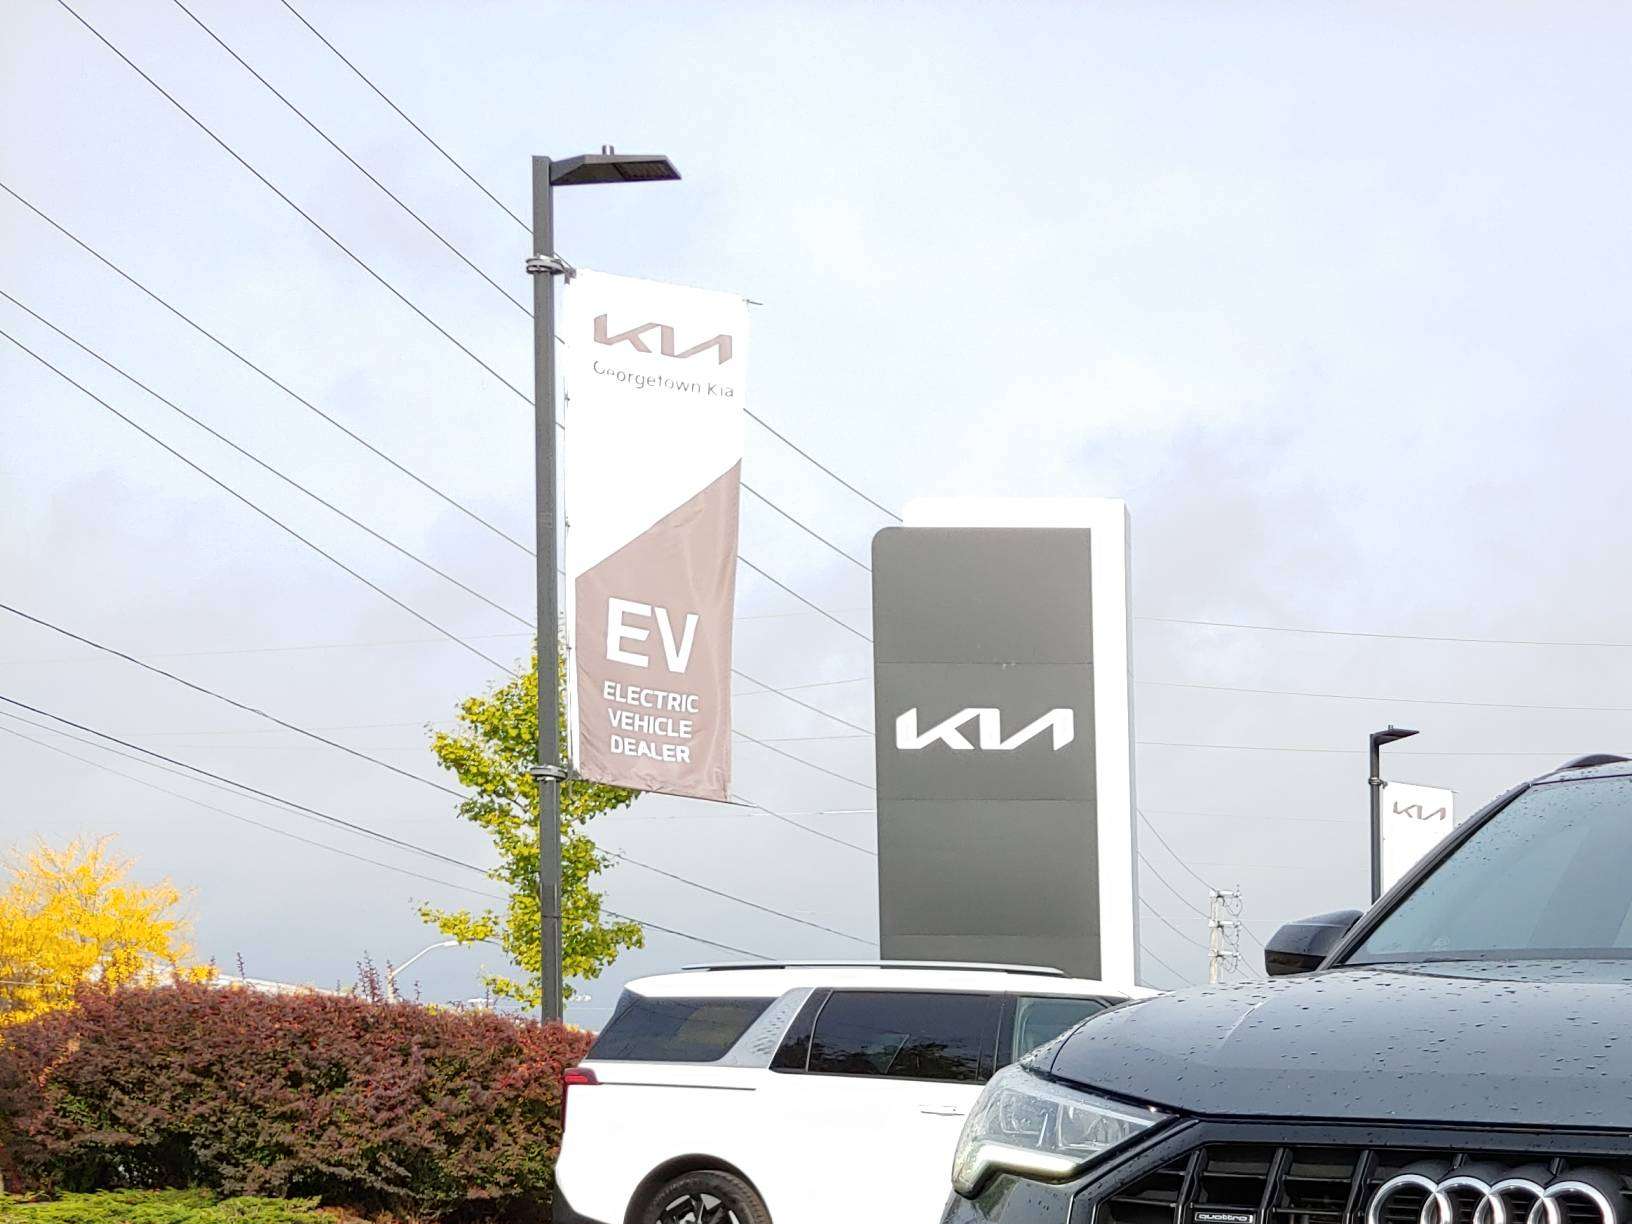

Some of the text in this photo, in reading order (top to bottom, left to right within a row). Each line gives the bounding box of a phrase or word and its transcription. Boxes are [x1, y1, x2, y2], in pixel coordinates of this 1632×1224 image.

[593, 313, 733, 366] KIA
[707, 382, 735, 399] Kia
[606, 597, 700, 674] EV
[603, 680, 700, 713] ELECTRIC
[607, 707, 693, 738] VEHICLE
[896, 707, 1075, 751] KIA
[610, 734, 691, 764] DEALER
[1392, 801, 1447, 821] KIA
